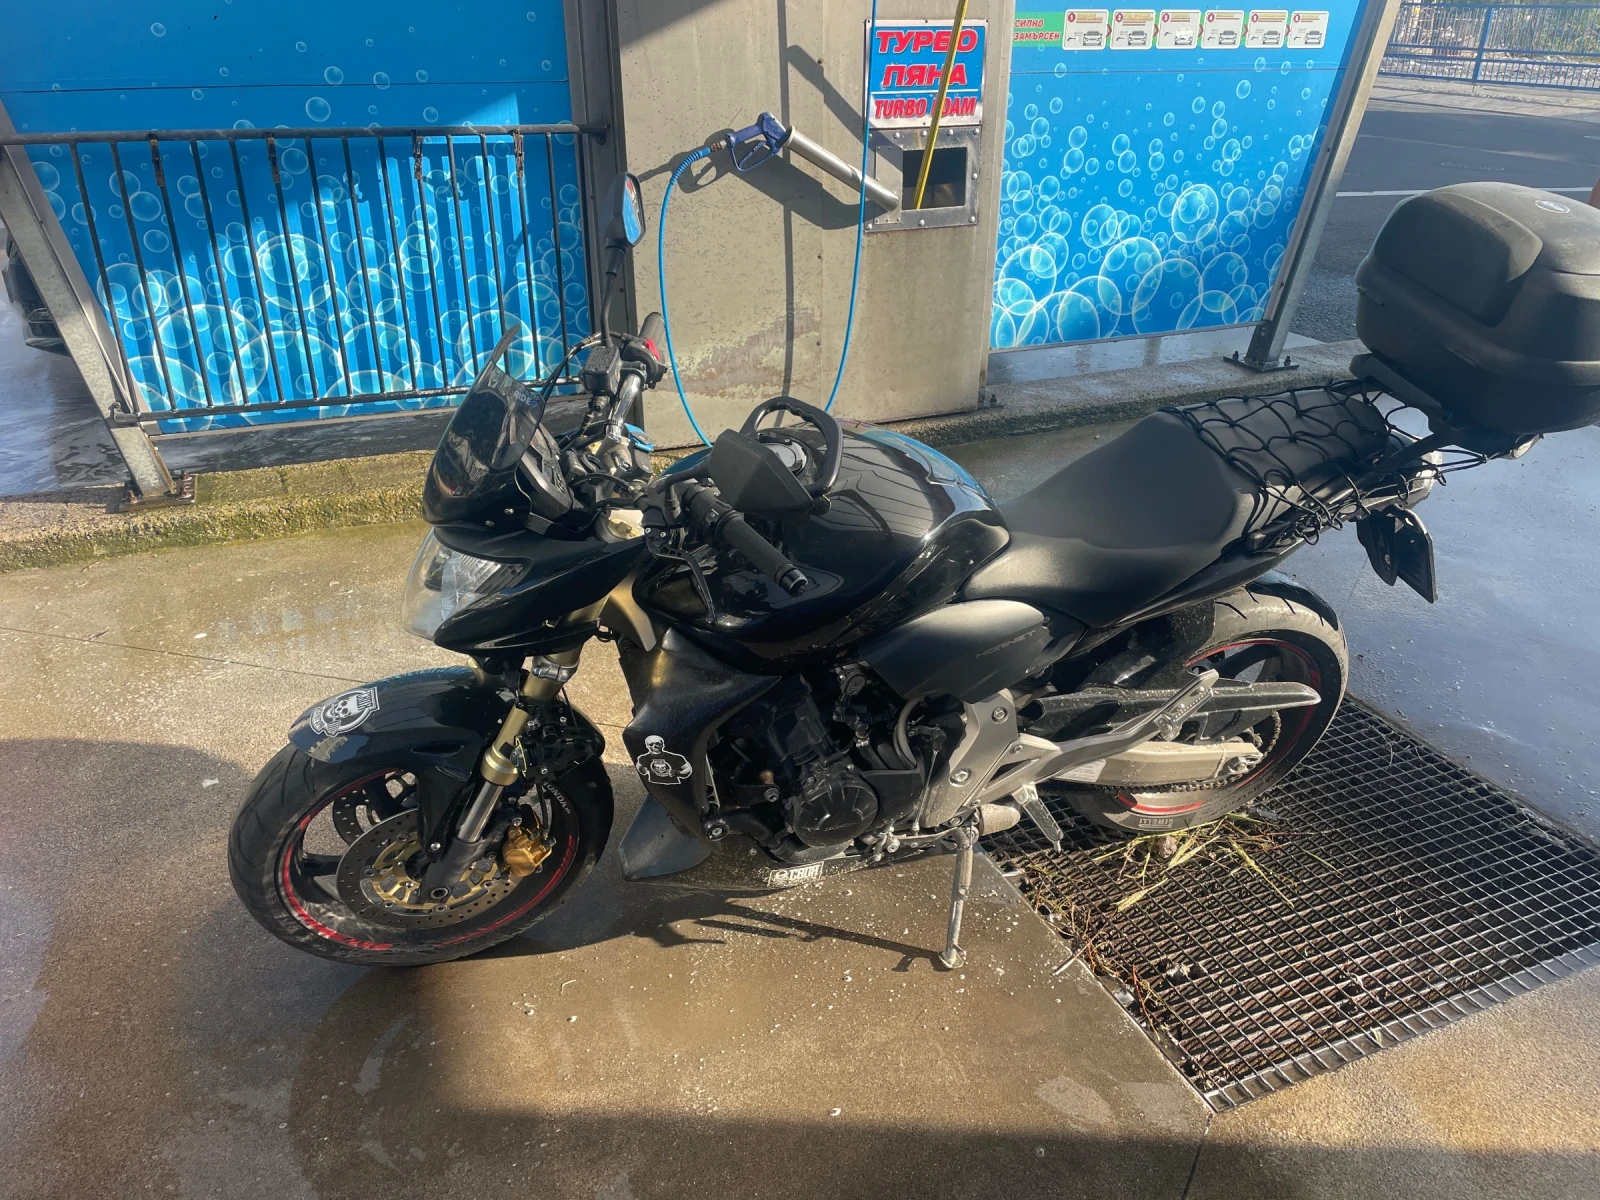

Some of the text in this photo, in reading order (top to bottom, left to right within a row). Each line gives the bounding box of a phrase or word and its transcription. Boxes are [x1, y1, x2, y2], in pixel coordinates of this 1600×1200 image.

[1014, 19, 1044, 28] СИЛНО
[876, 29, 978, 53] ТУРБО
[1013, 32, 1060, 41] ЗАМЪРСЕН
[882, 63, 967, 87] ПЯНА
[874, 98, 928, 119] TURBO
